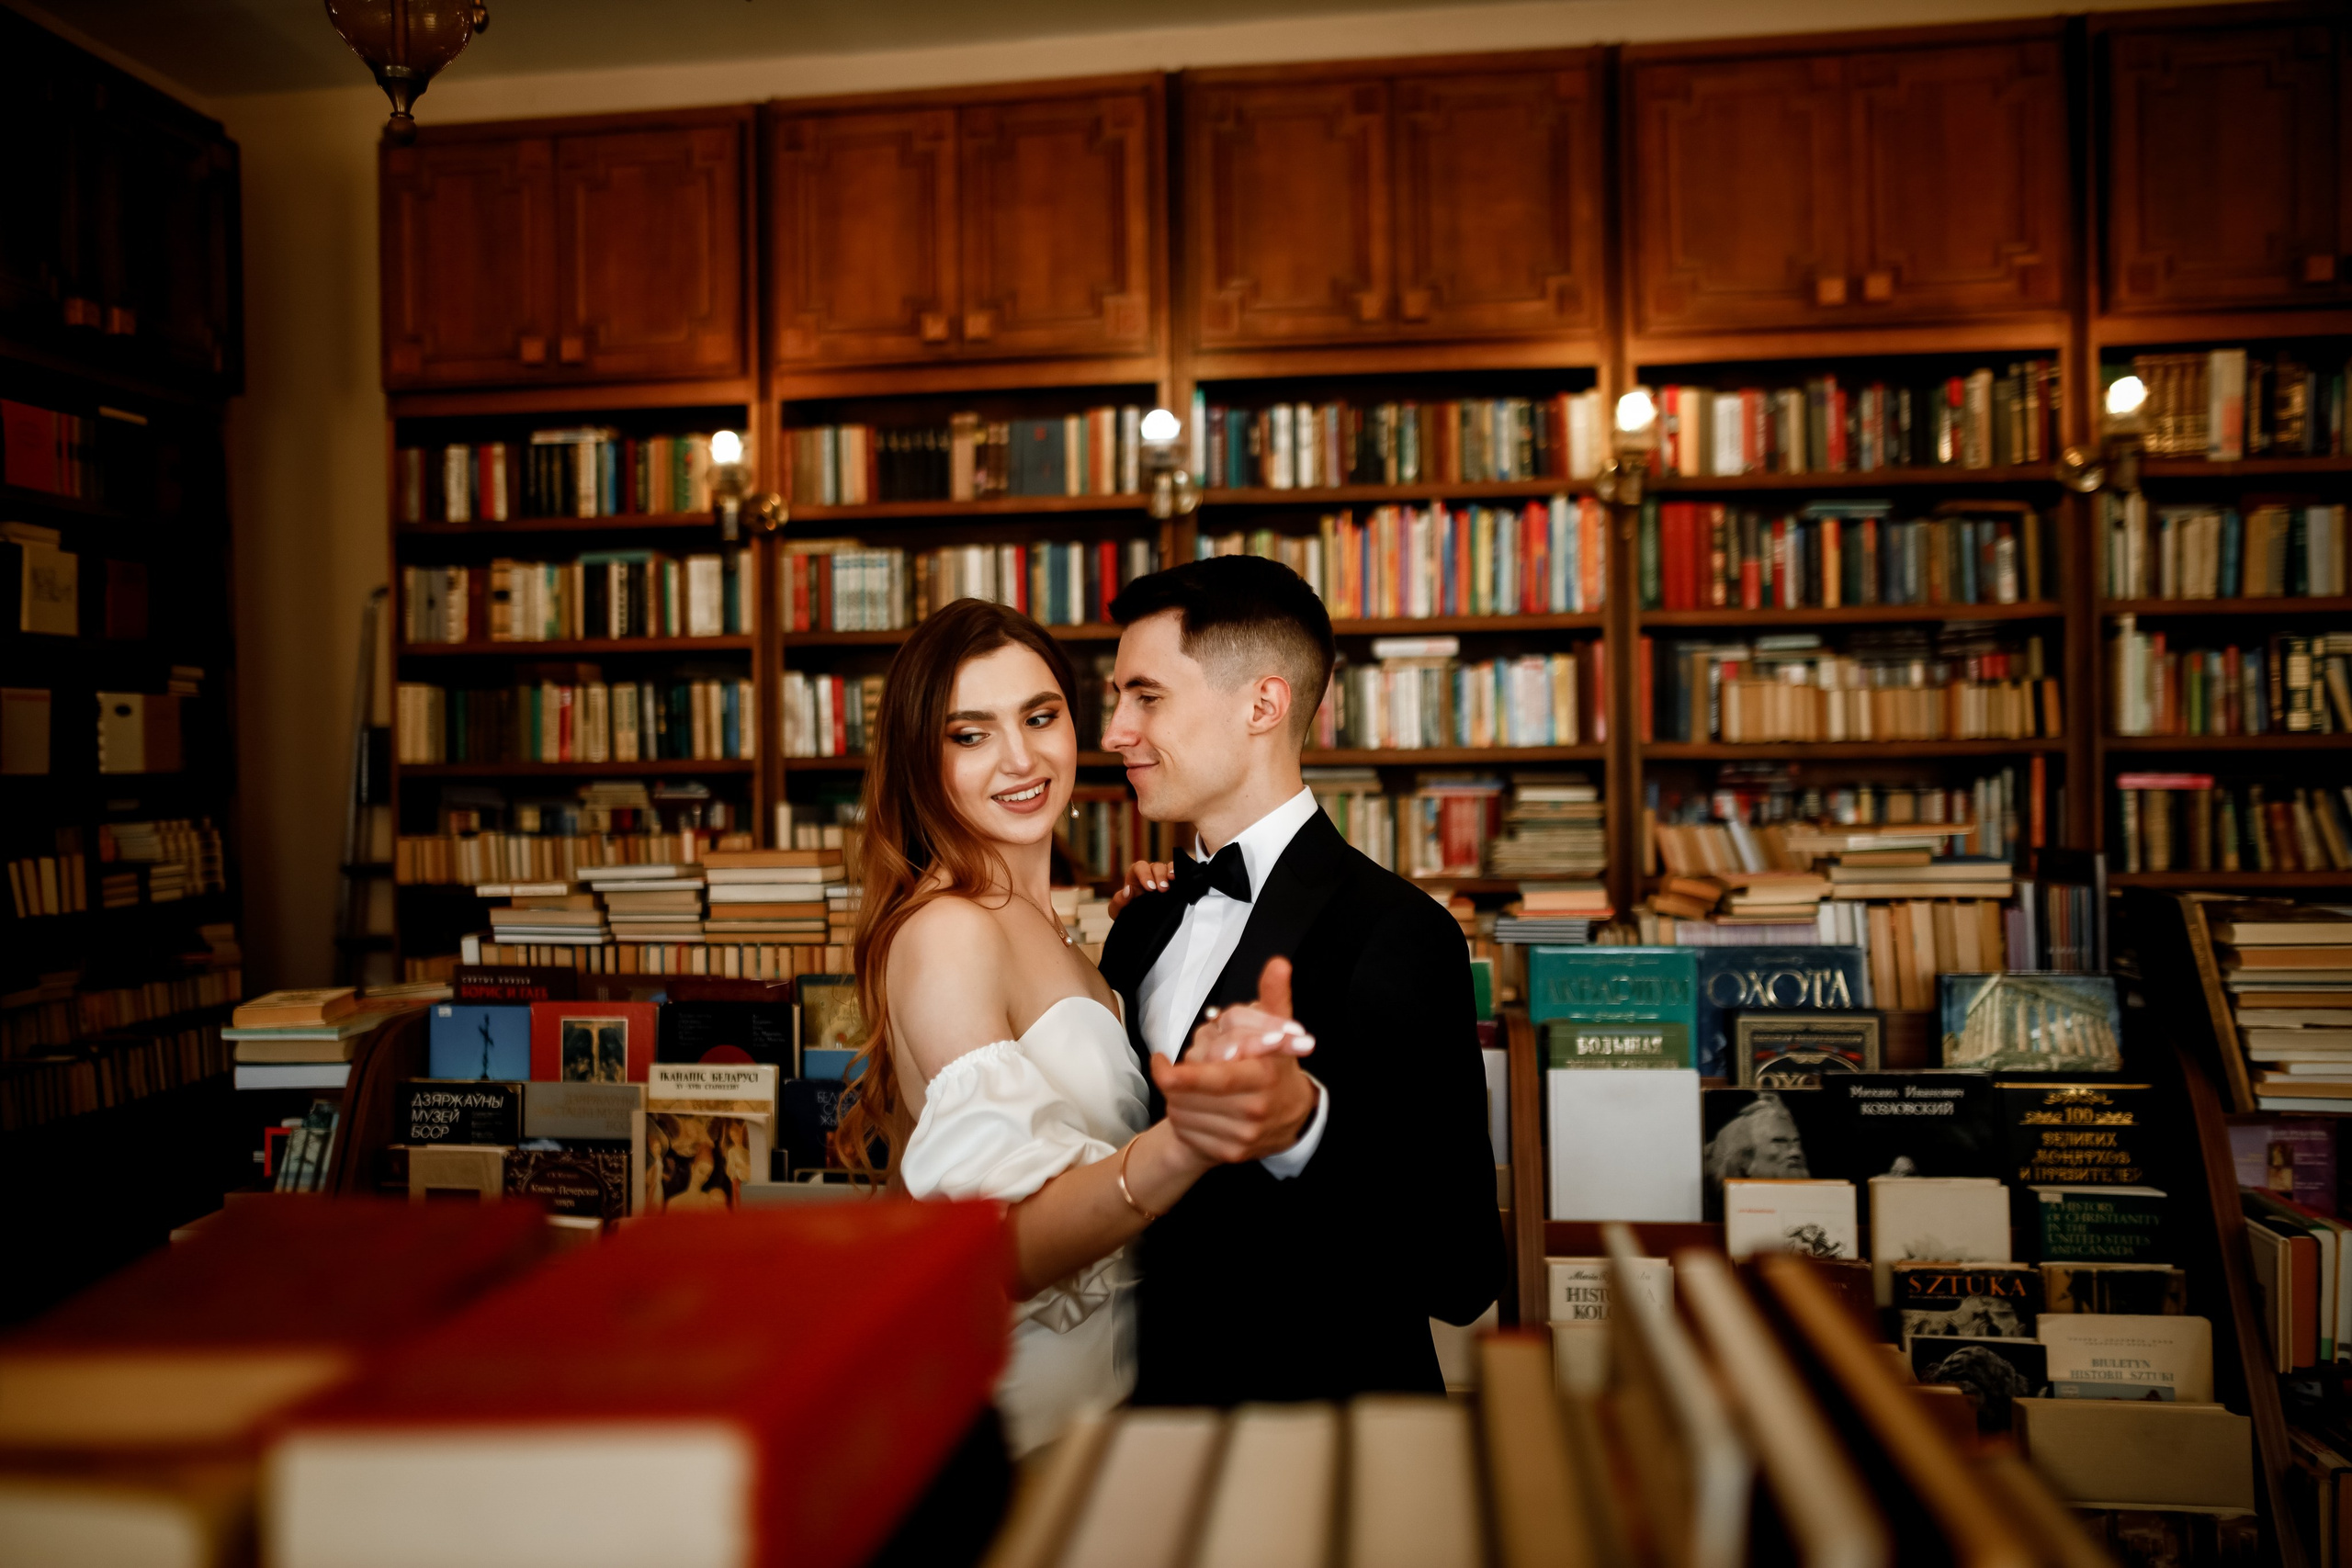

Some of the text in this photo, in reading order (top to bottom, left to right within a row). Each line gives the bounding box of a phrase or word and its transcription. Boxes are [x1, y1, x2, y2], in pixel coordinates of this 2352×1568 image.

[461, 986, 503, 998] БОРИС
[506, 987, 515, 998] И
[1706, 968, 1852, 1008] ОХОТА
[1576, 1036, 1662, 1055] БОЛЬШАЯ
[411, 1091, 503, 1109] ДЗЯРЖАЎНЫ
[1860, 1101, 1954, 1115] КОЗЛОВСКИЙ
[2064, 1106, 2095, 1123] 100
[411, 1109, 460, 1123] МУЗЕЙ
[411, 1125, 449, 1139] БССР
[2041, 1131, 2118, 1148] ВЕЛИКИХ
[2018, 1166, 2031, 1180] И
[2061, 1201, 2114, 1213] HISTORY
[2065, 1213, 2160, 1226] CHRISTIANITY
[2047, 1234, 2152, 1247] UNITED STATES
[1908, 1275, 2027, 1296] SZTUKA
[2091, 1359, 2152, 1368] BIULETYN
[2071, 1370, 2175, 1382] HISTORII SZTUKI
